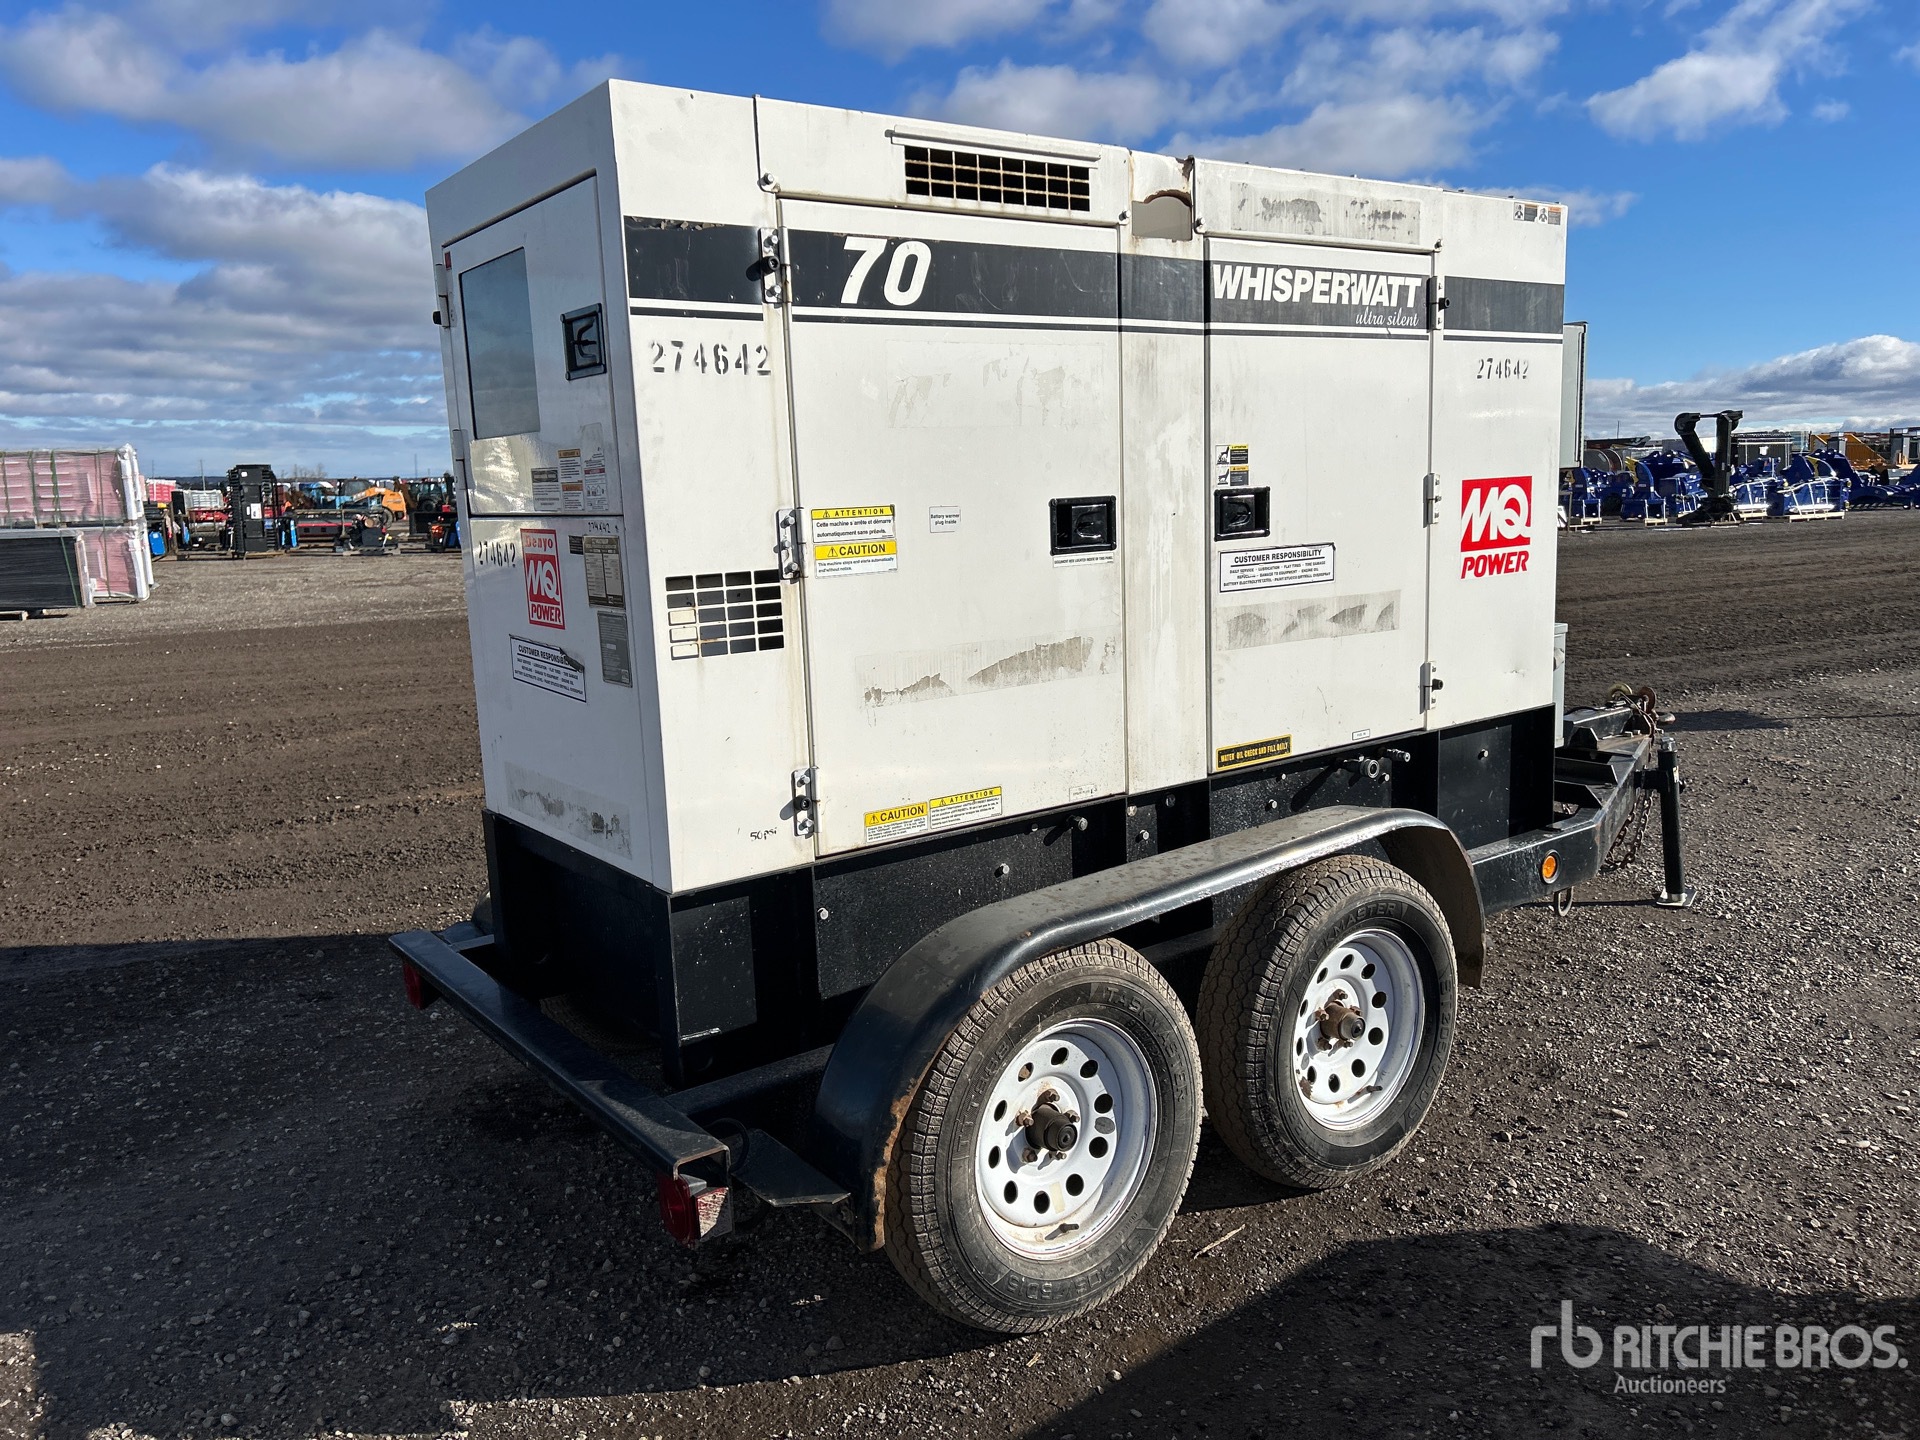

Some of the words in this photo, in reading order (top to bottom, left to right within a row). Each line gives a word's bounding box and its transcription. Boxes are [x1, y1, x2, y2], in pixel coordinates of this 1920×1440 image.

[841, 236, 932, 306] 70
[1212, 264, 1423, 308] WHISPERWATT
[1355, 306, 1385, 325] ultra
[1386, 307, 1420, 327] silent
[651, 340, 772, 376] 274642
[1476, 357, 1529, 380] 274642
[834, 508, 885, 517] ATTENTION
[1461, 484, 1532, 542] MQ
[479, 541, 516, 568] 274642
[525, 535, 554, 552] Denyo
[839, 543, 886, 556] CAUTION
[1234, 553, 1270, 564] CUSTOMER
[1271, 549, 1322, 560] RESPONSIBILITY
[1461, 550, 1530, 580] POWER
[527, 560, 560, 602] MQ
[531, 603, 562, 623] POWER
[518, 644, 540, 657] CUSTOMER
[1244, 748, 1258, 758] CHECK
[949, 790, 994, 804] ATTENTION
[880, 804, 925, 822] CAUTION
[1298, 901, 1397, 986] TASKMASTER
[1102, 985, 1189, 1103] TASKMASTER
